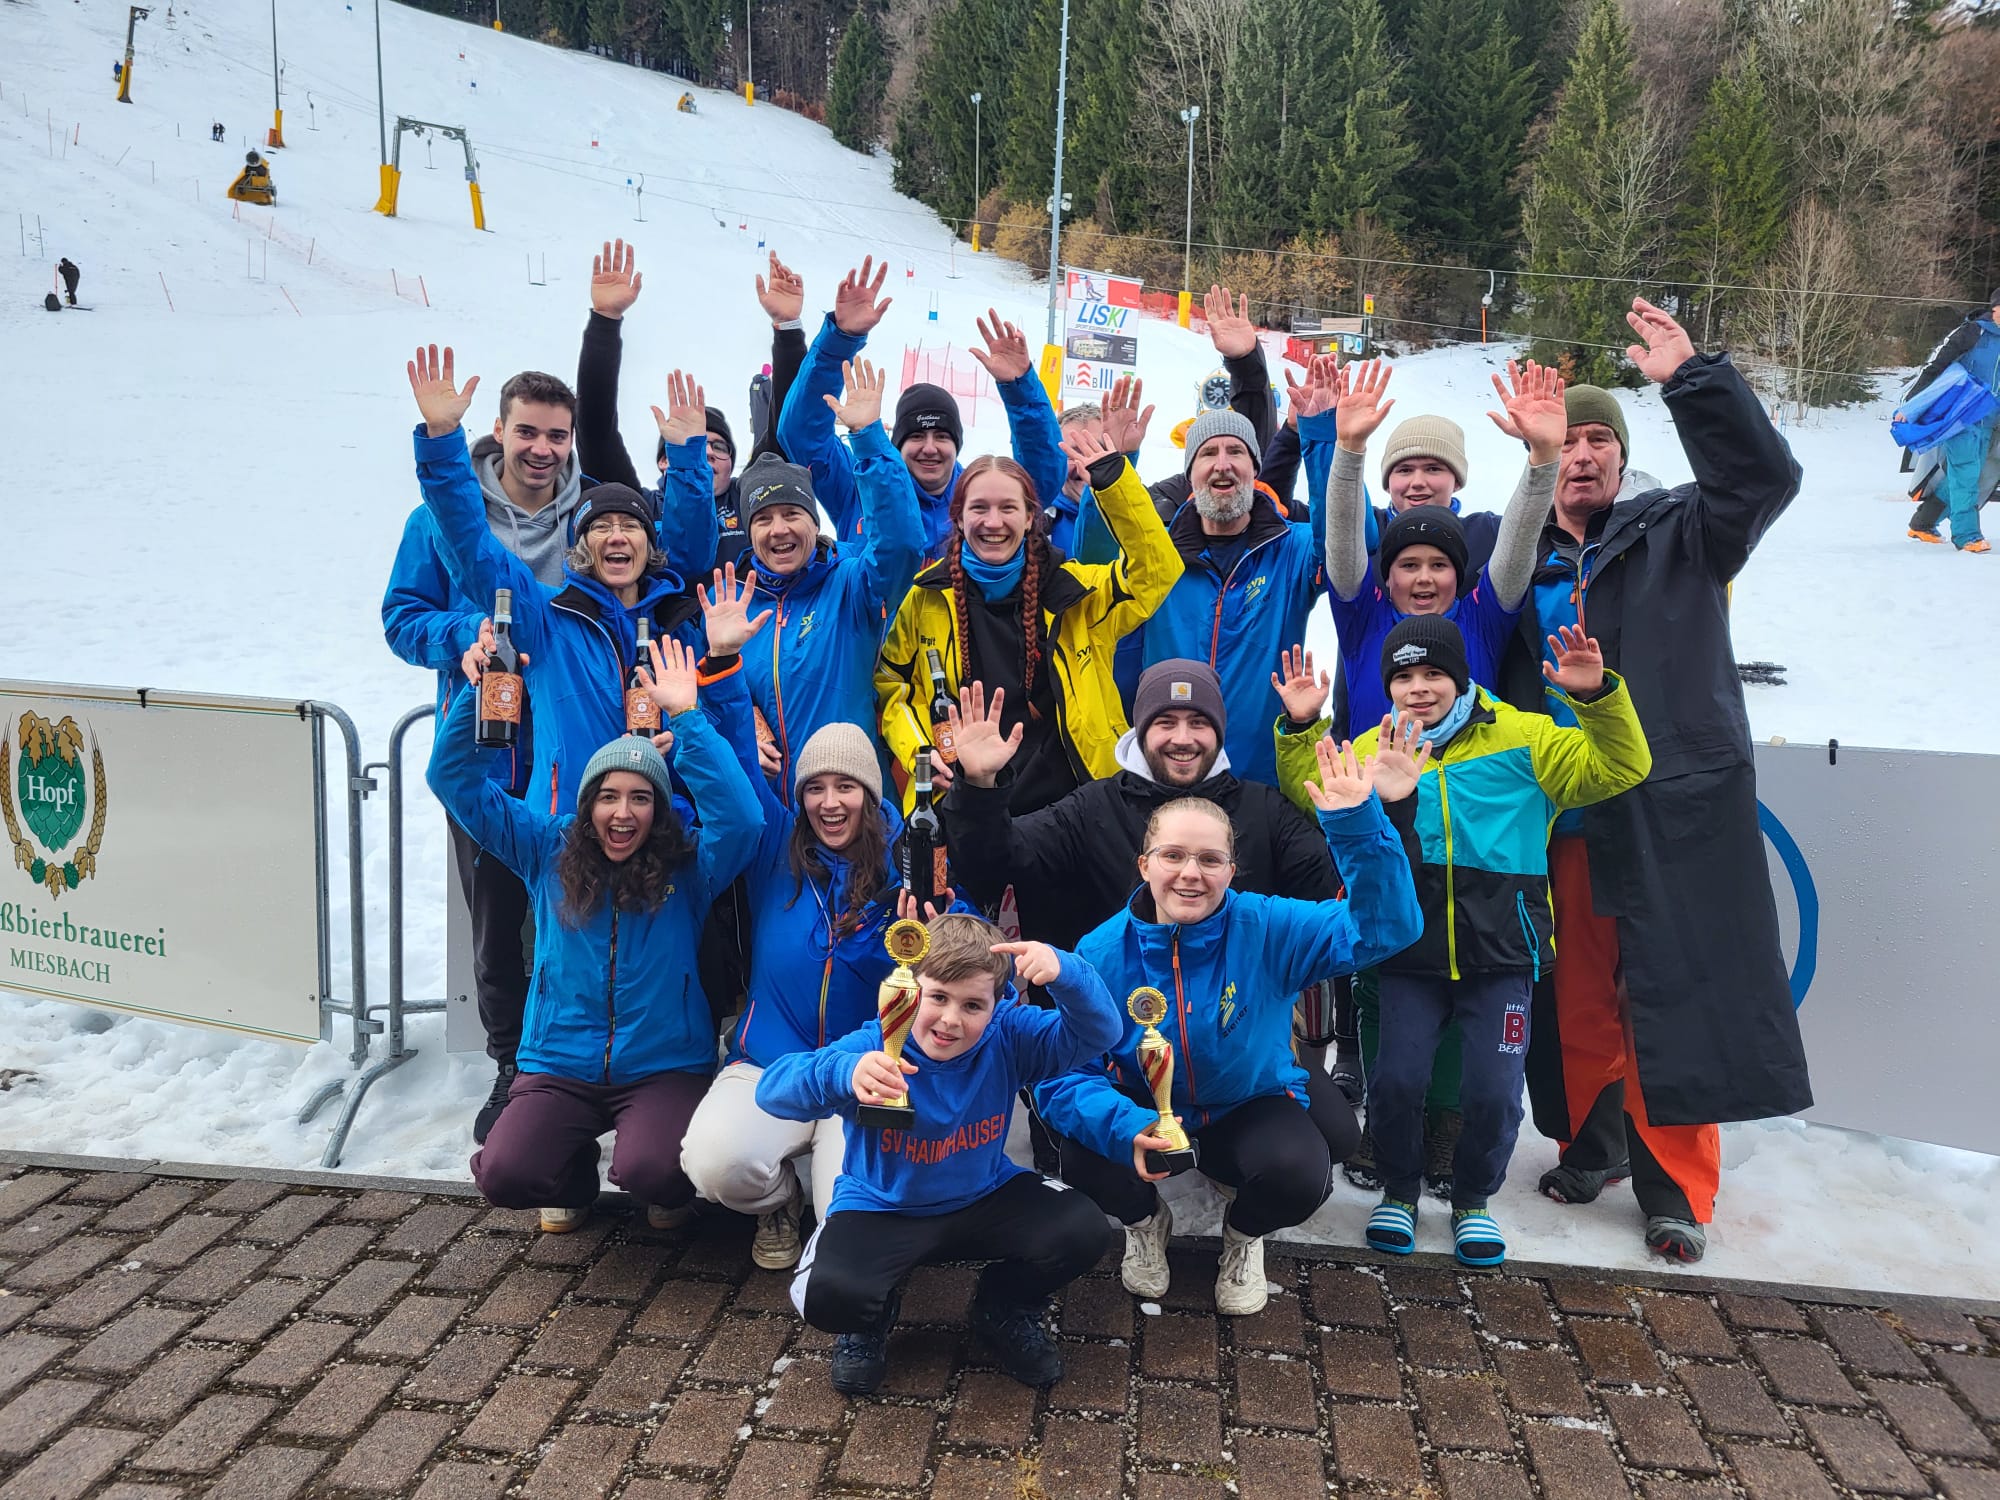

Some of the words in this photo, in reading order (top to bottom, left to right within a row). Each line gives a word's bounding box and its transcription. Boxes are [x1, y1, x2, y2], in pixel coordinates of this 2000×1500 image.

[1077, 303, 1128, 328] LISKI
[27, 774, 77, 813] Hopf
[10, 947, 112, 984] MIESBACH
[1503, 1011, 1525, 1045] B
[881, 1128, 903, 1153] SV
